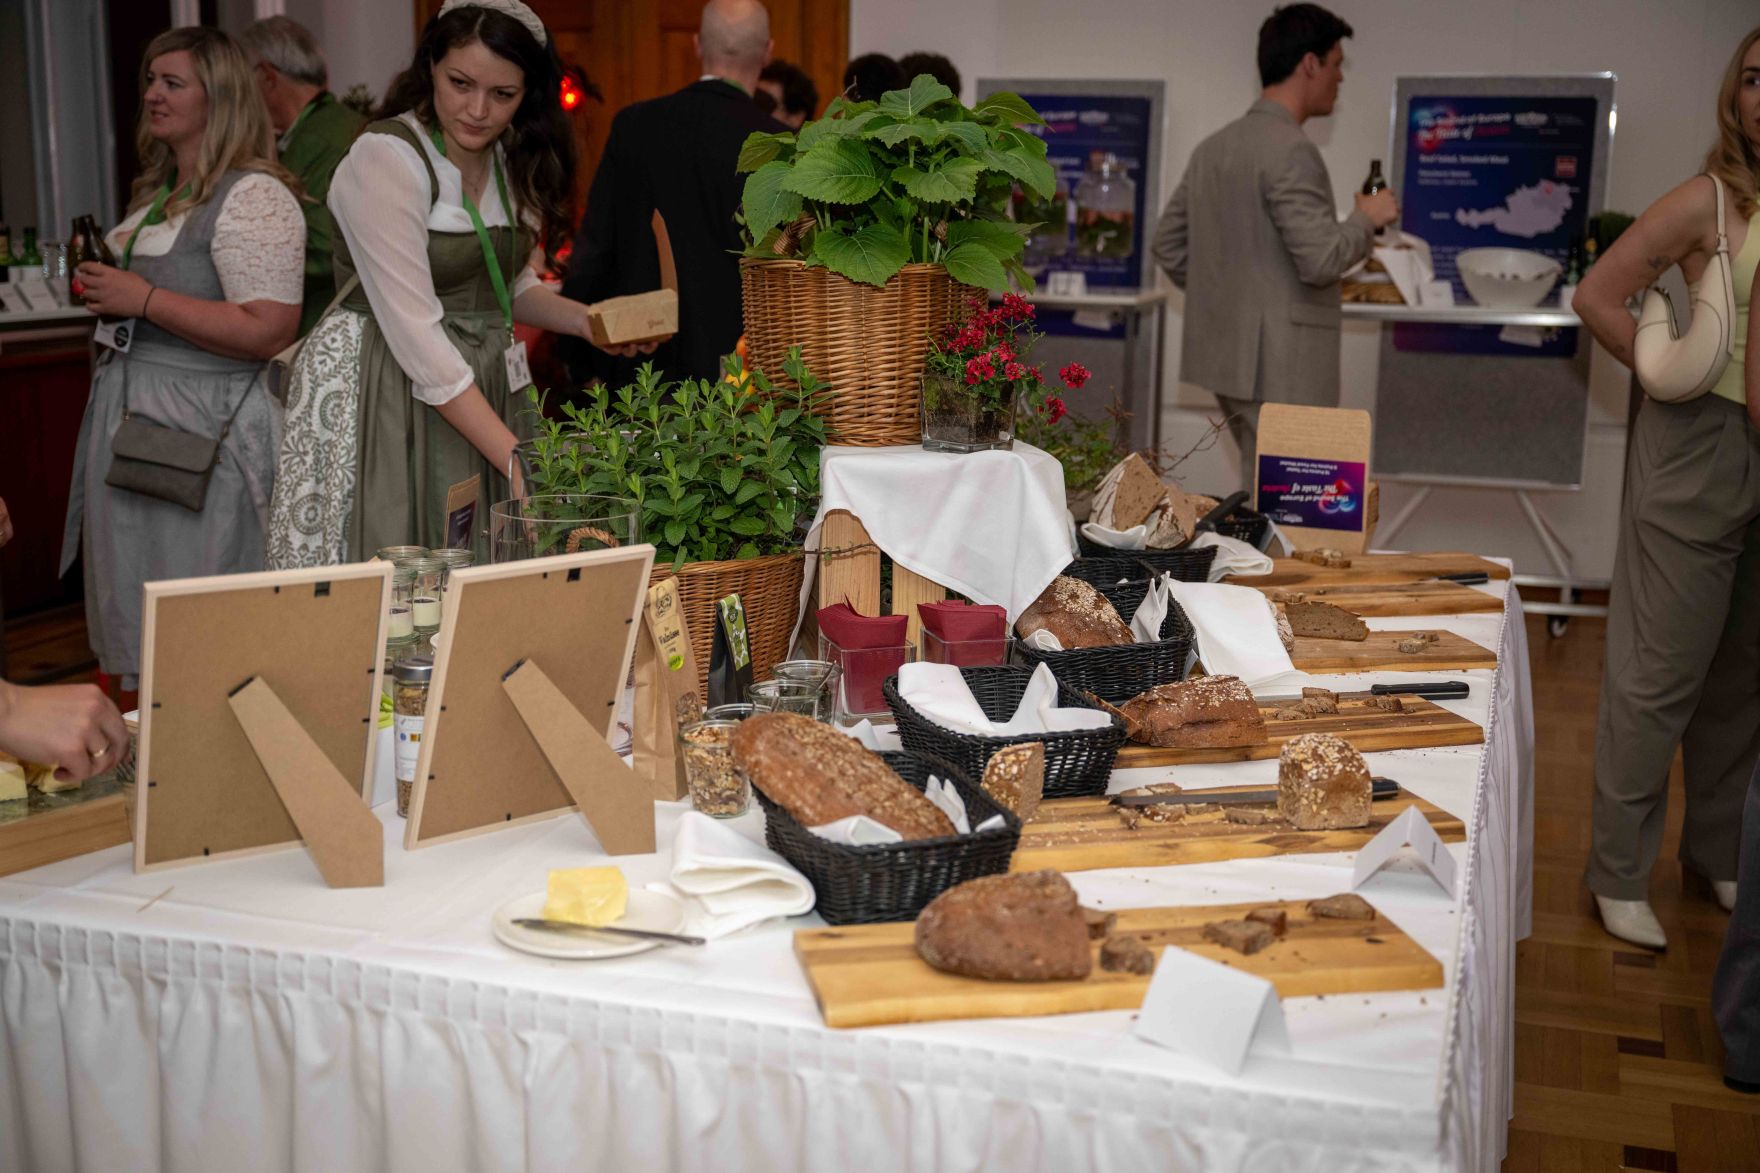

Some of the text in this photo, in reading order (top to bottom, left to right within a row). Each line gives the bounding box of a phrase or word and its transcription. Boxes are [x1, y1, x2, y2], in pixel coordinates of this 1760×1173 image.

[1291, 482, 1300, 494] of
[1301, 484, 1323, 495] Taste
[1324, 484, 1339, 494] The
